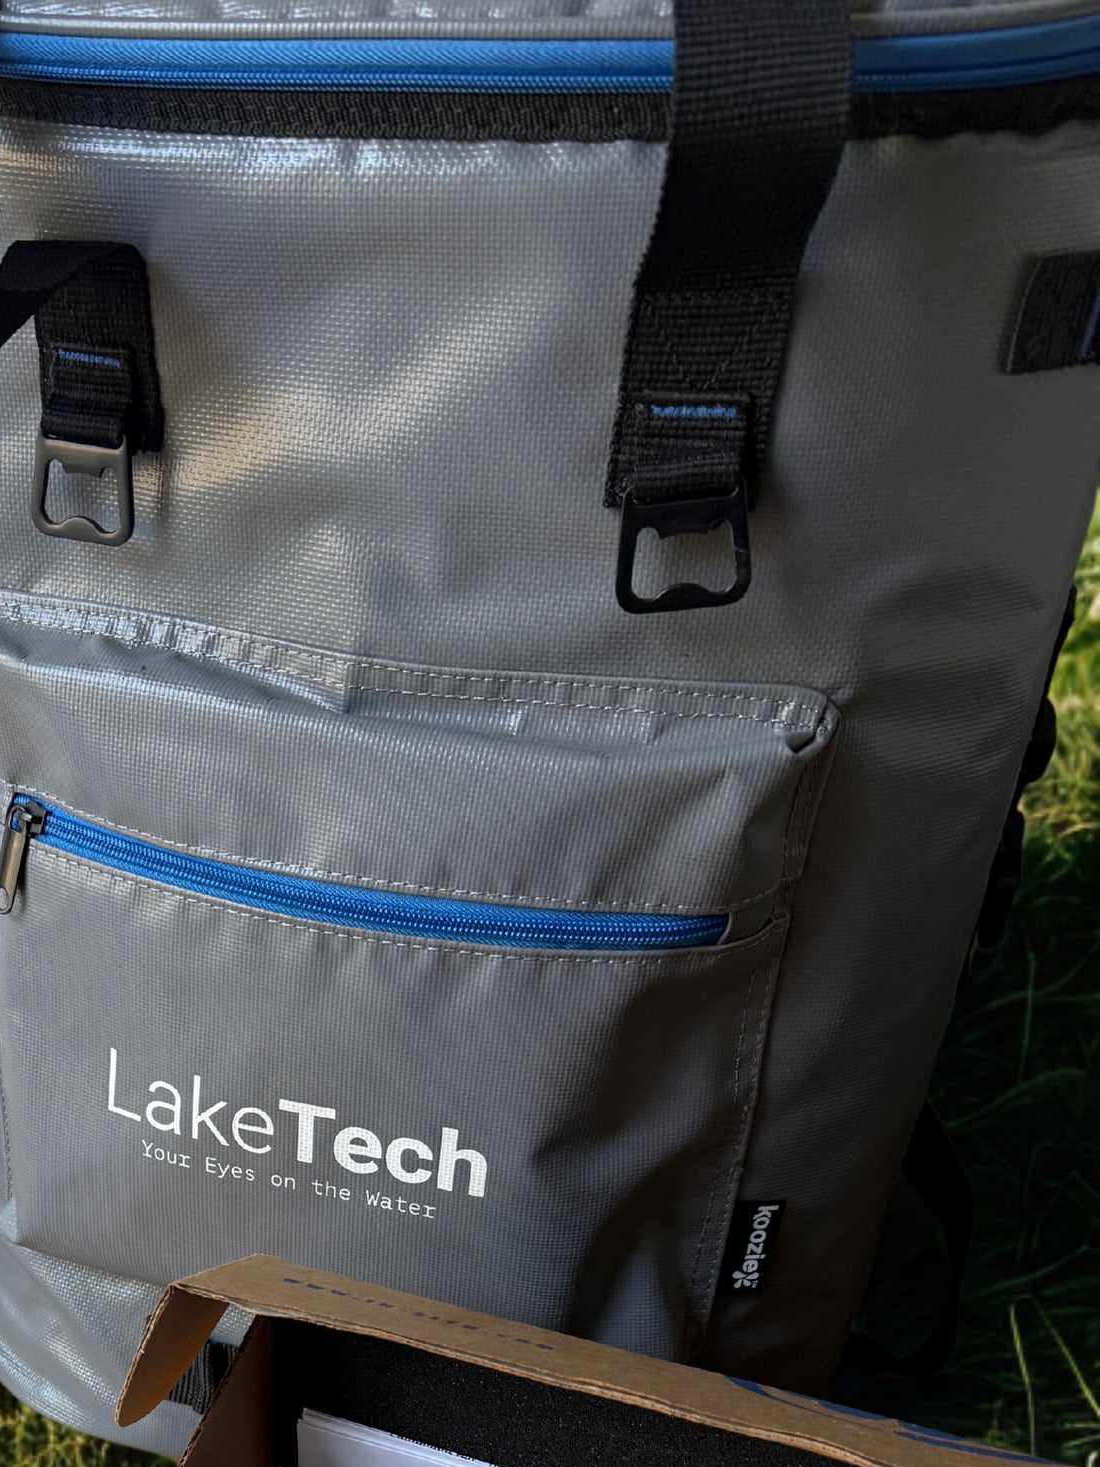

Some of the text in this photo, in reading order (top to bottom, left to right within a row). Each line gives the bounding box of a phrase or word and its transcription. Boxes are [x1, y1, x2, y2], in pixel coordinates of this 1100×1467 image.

[107, 1048, 488, 1198] LakeTech
[141, 1139, 436, 1219] Your Eyes on the Water
[742, 1205, 779, 1273] koozie
